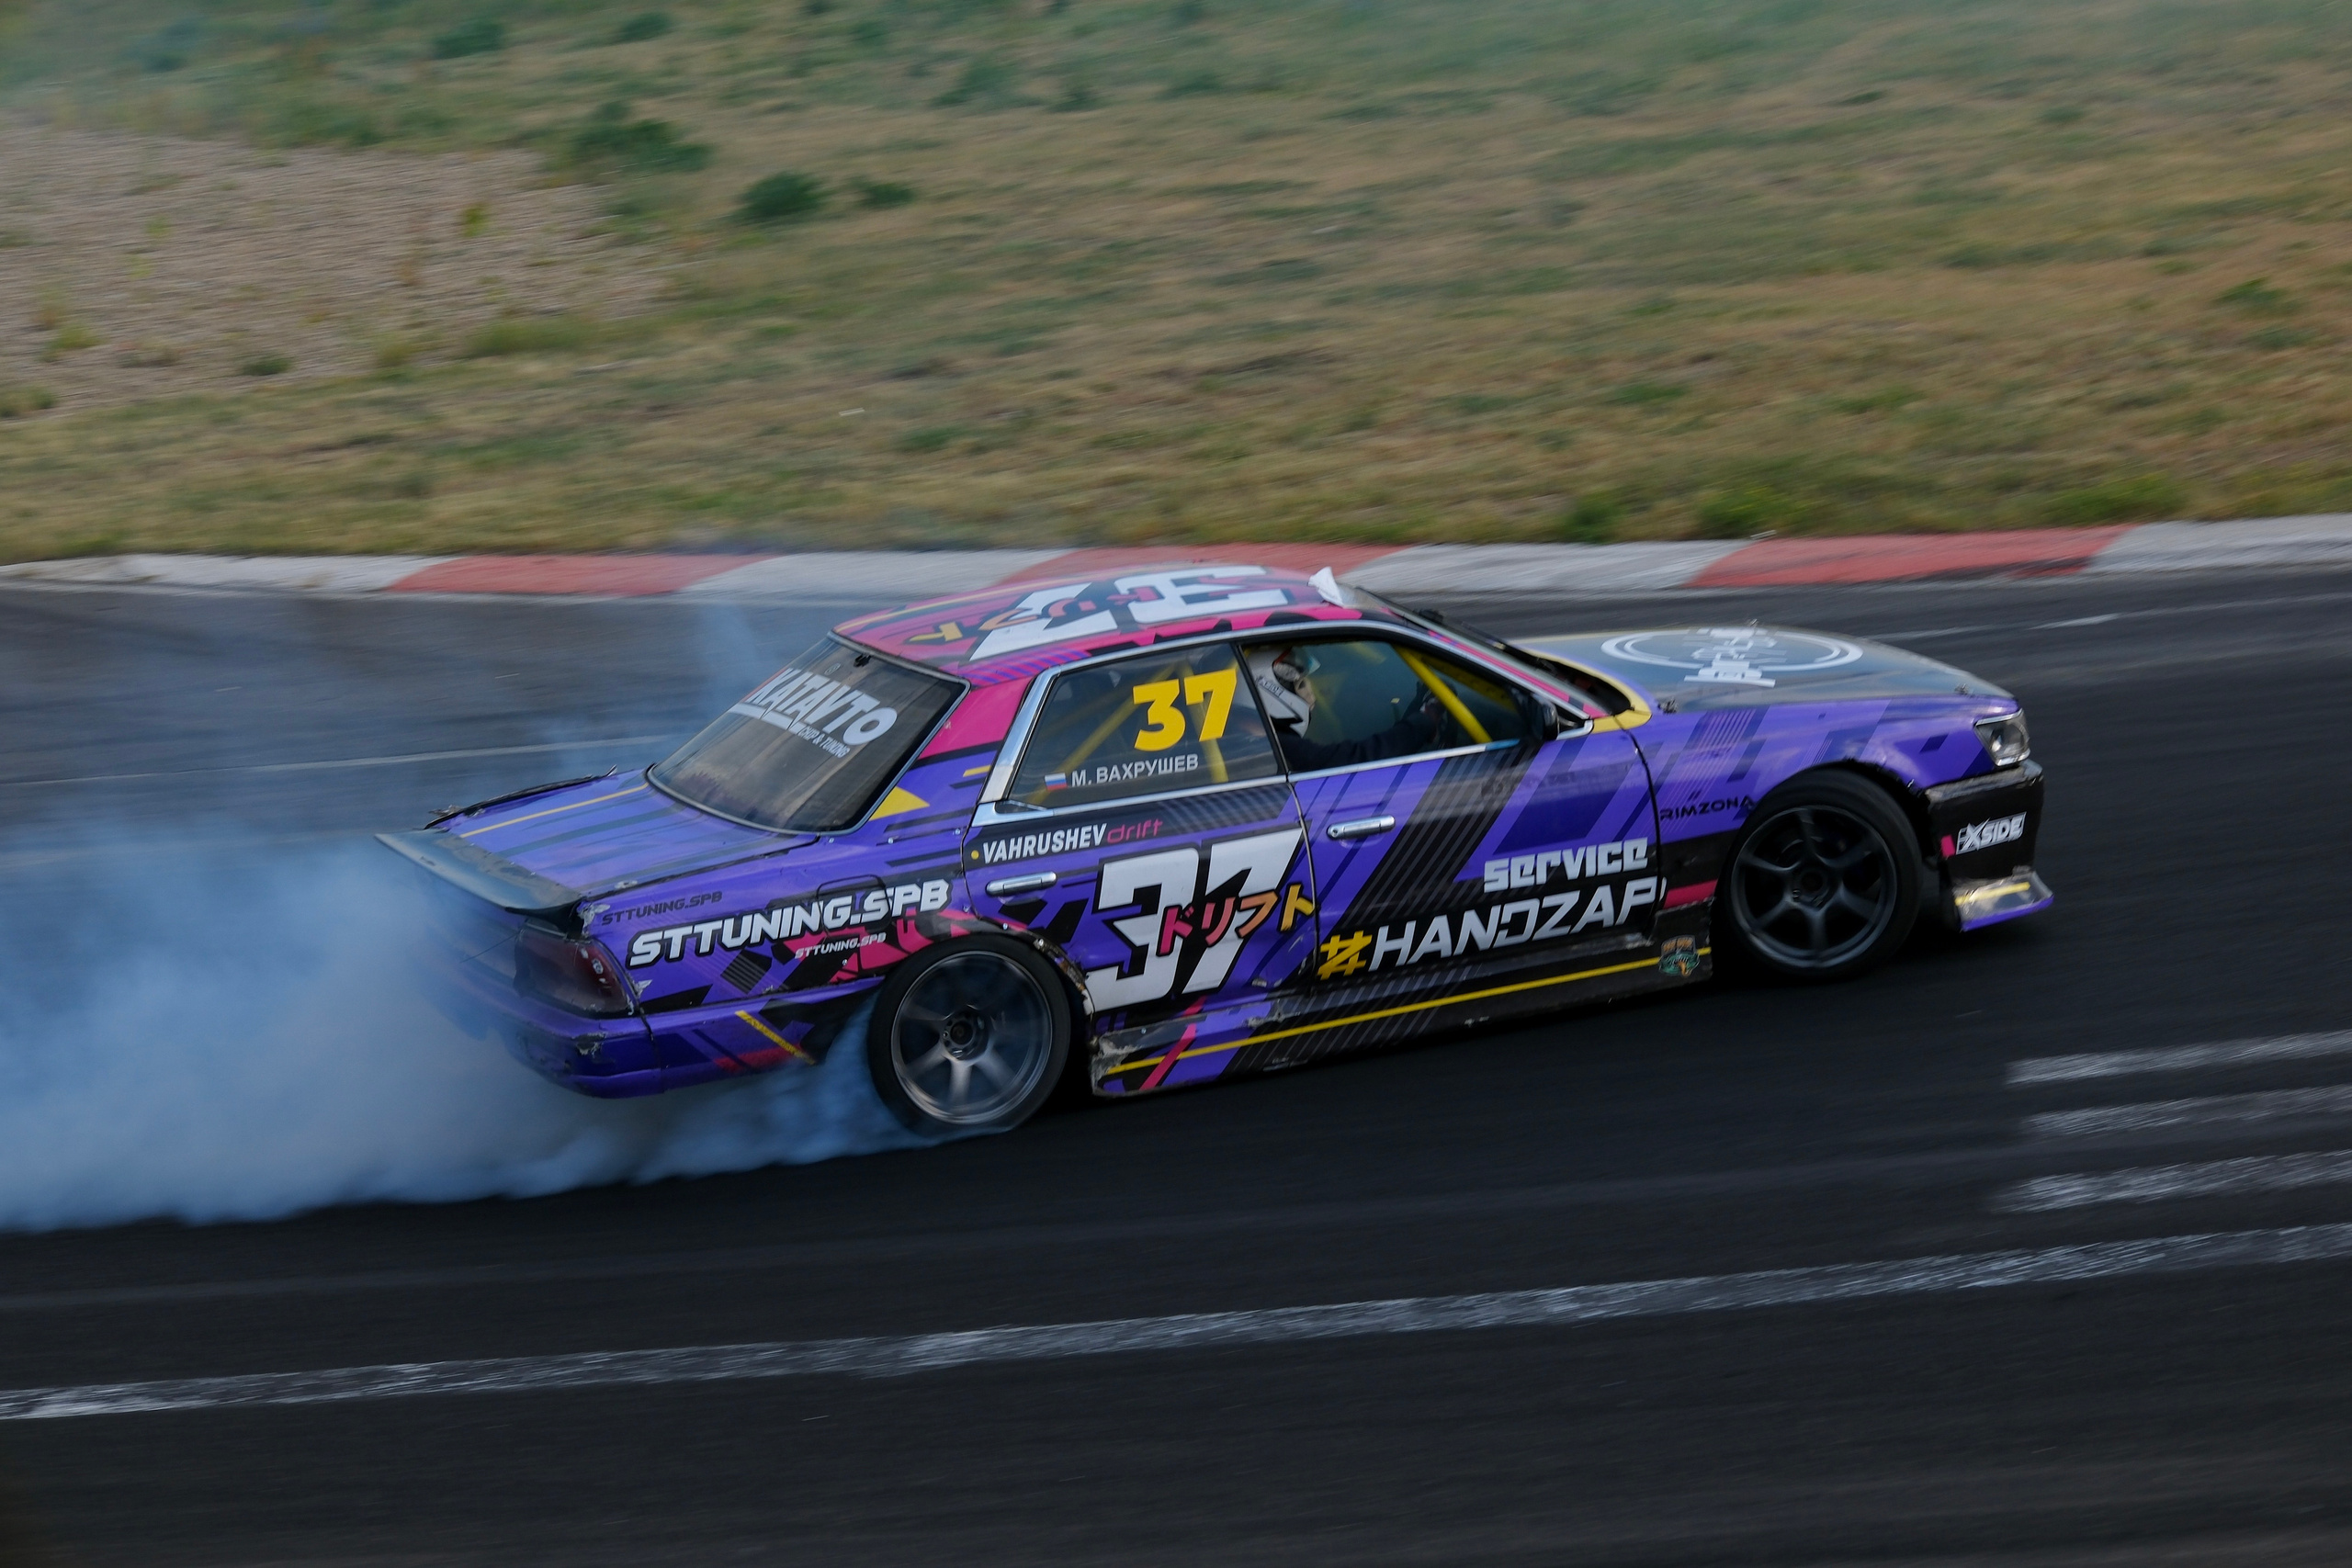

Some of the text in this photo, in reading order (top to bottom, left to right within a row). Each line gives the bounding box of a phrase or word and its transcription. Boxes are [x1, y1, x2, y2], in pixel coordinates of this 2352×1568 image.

[1132, 669, 1238, 751] 37
[820, 737, 851, 759] TUNING
[1071, 753, 1200, 788] М. ВАХРУШЕВ
[1659, 794, 1757, 821] RIMZONA
[982, 818, 1163, 864] VAHRUSHEV drift
[602, 891, 723, 927] STTUNING.SPB
[629, 878, 951, 967] STTUNING.SPB
[1084, 827, 1305, 1012] 37
[1159, 883, 1316, 955] ドリフト
[794, 932, 888, 960] STTUNING.SPB
